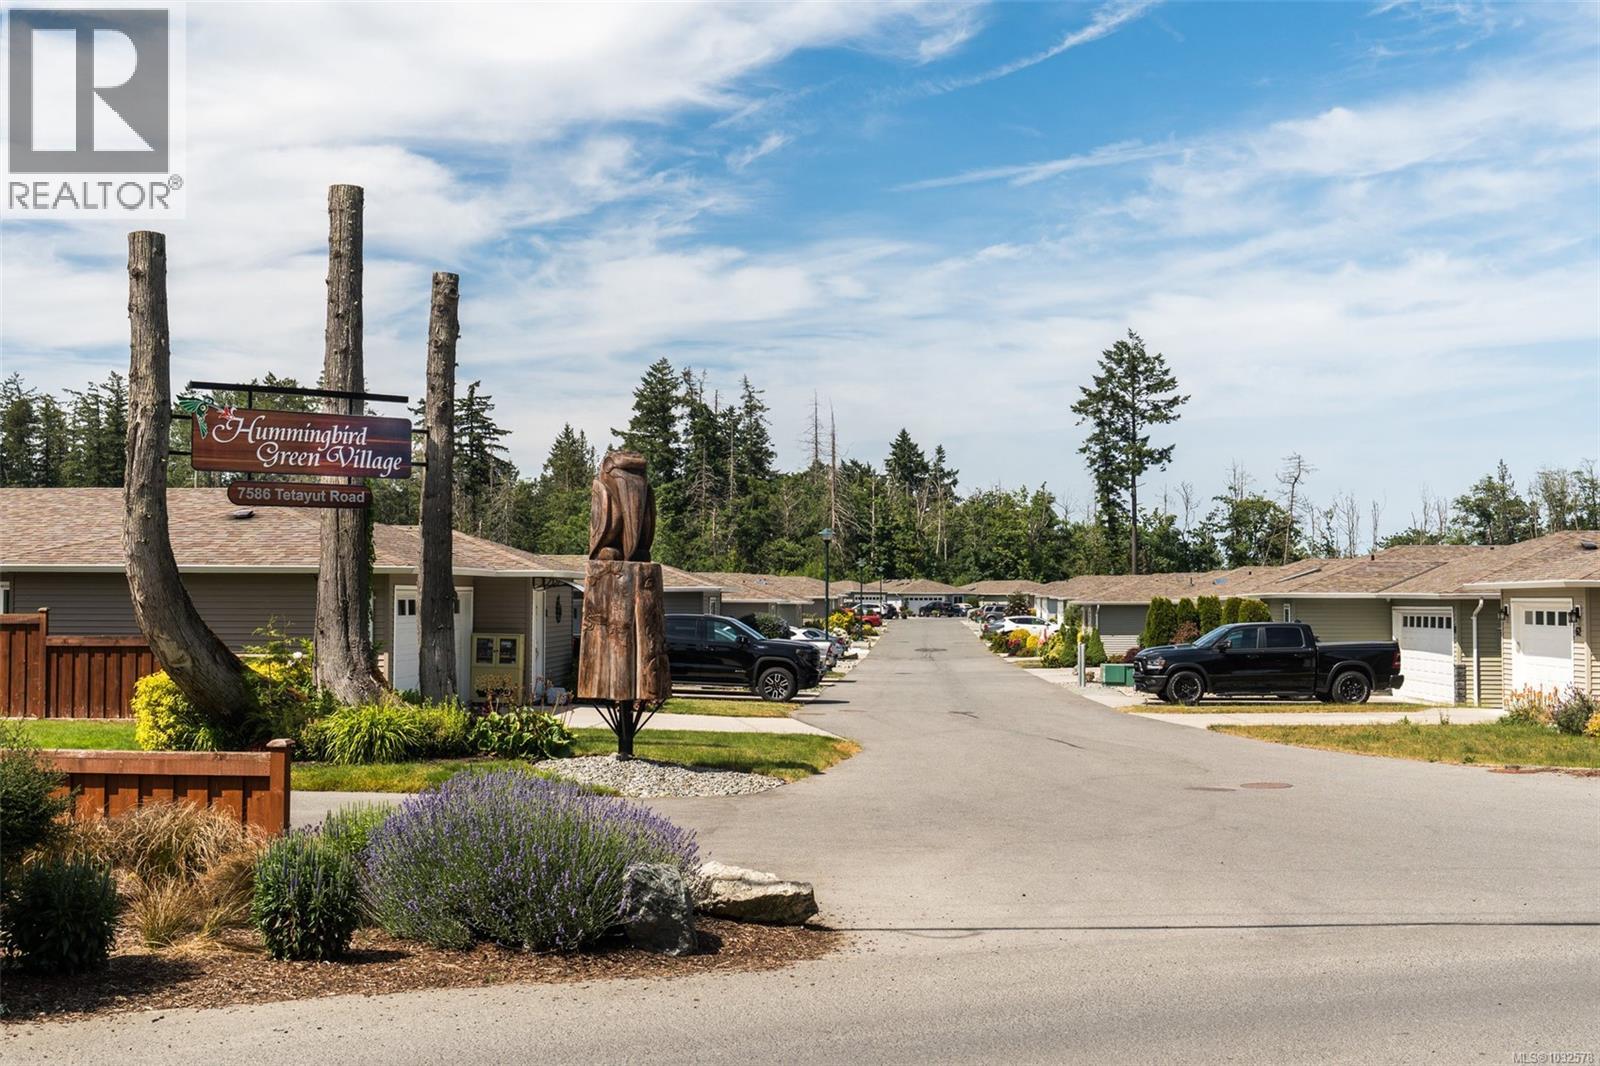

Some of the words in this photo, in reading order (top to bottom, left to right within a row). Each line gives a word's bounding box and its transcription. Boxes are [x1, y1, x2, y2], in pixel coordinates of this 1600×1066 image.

[212, 415, 367, 450] Hummingbird
[256, 441, 321, 468] Green
[327, 445, 402, 477] Village
[237, 487, 271, 500] 7586
[275, 489, 327, 504] Tetayut
[330, 491, 366, 503] Road
